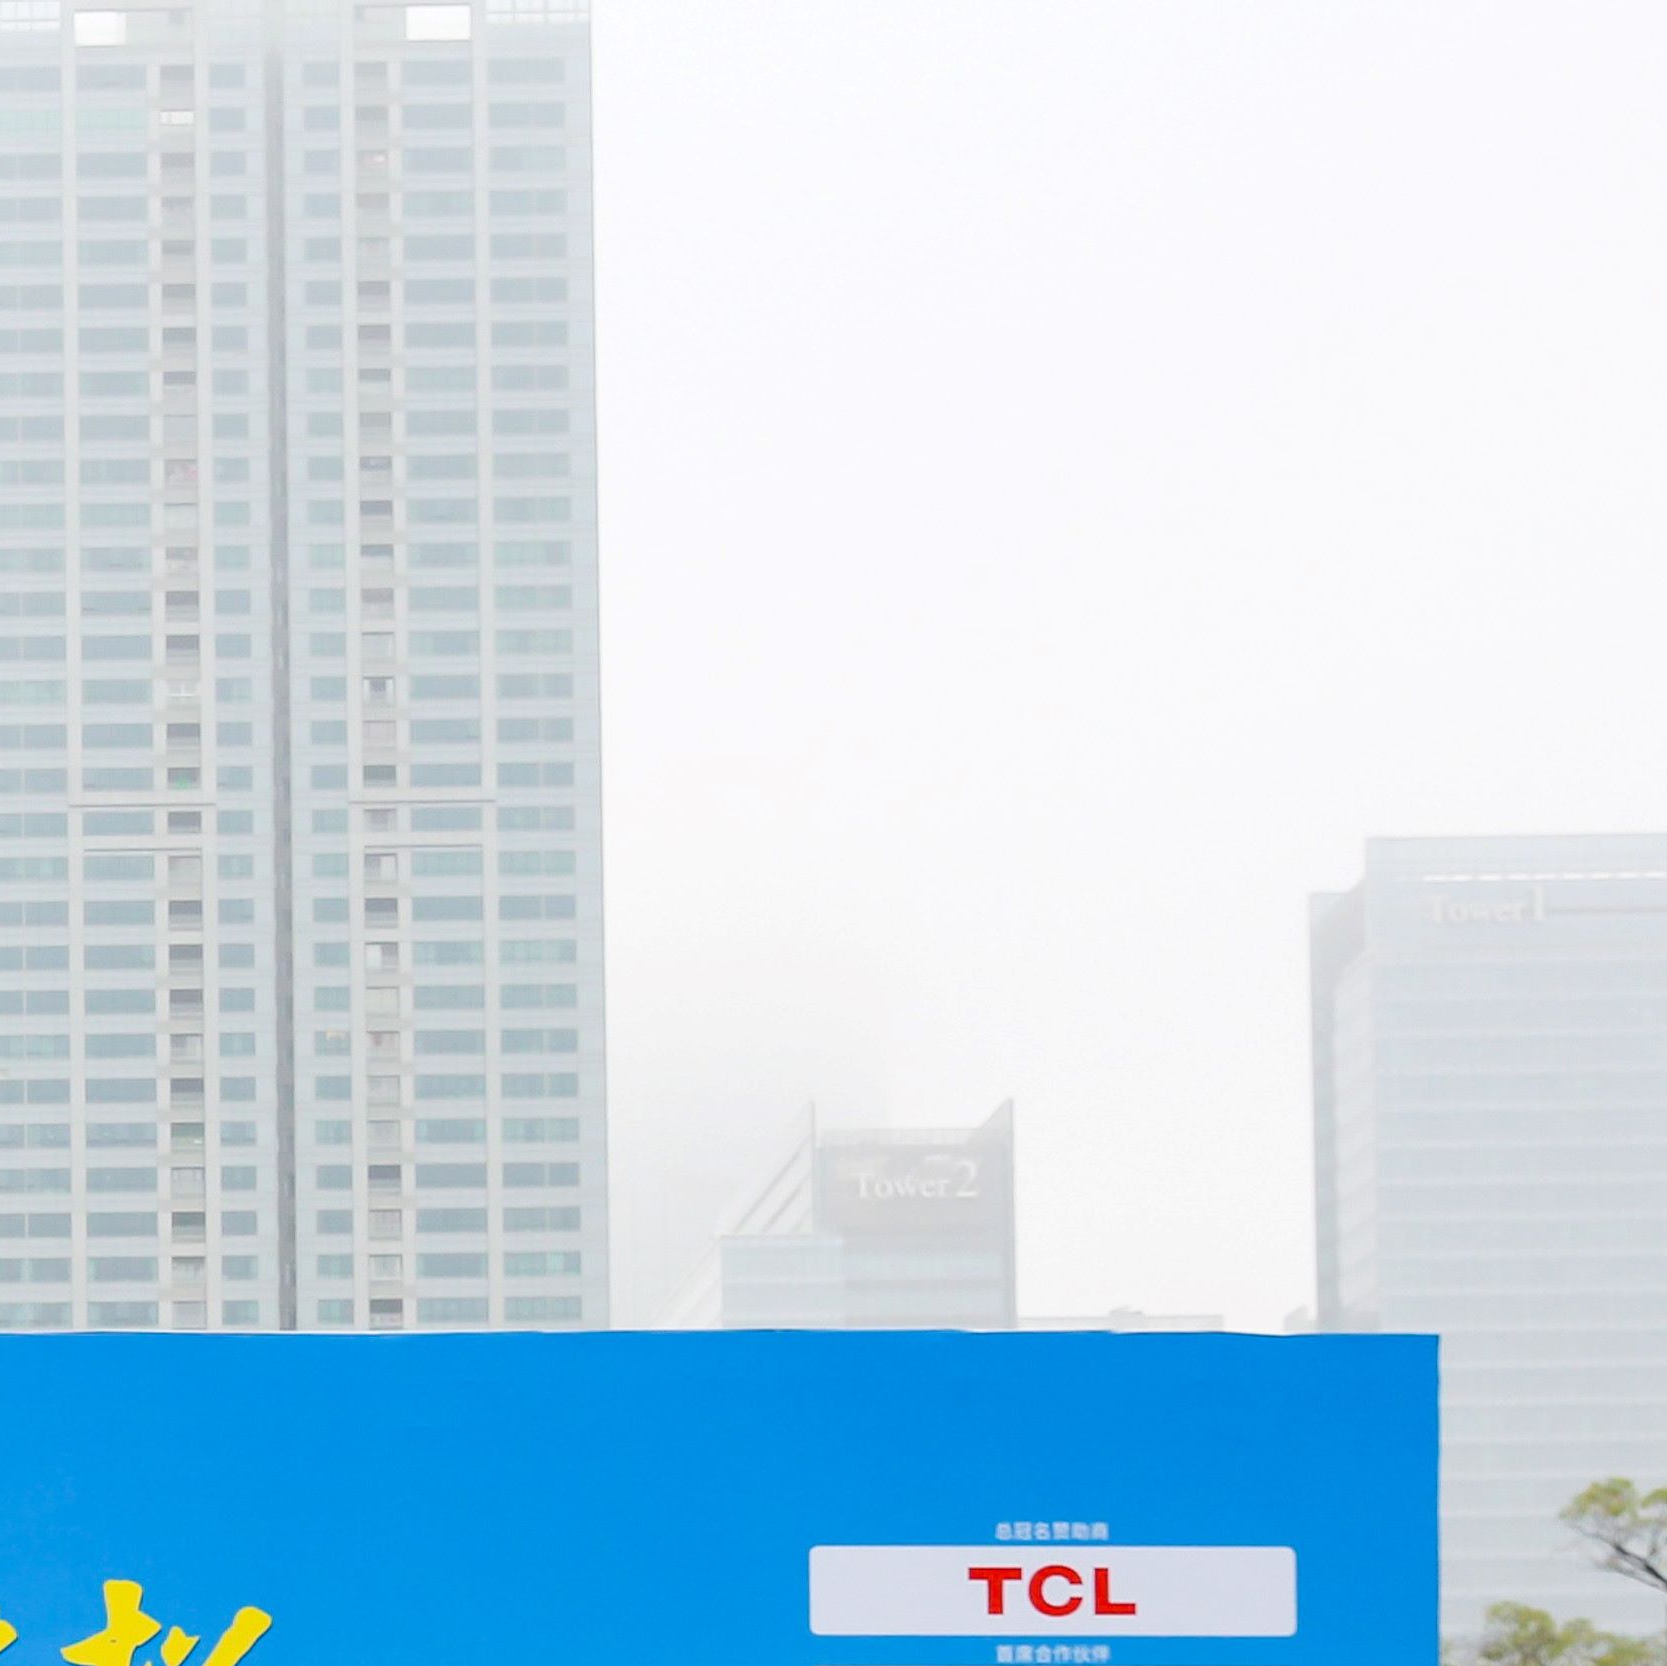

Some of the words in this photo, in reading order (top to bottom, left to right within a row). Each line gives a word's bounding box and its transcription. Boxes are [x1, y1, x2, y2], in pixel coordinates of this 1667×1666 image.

[856, 1173, 950, 1199] Tower
[956, 1159, 980, 1198] 2
[968, 1565, 1136, 1616] TCL
